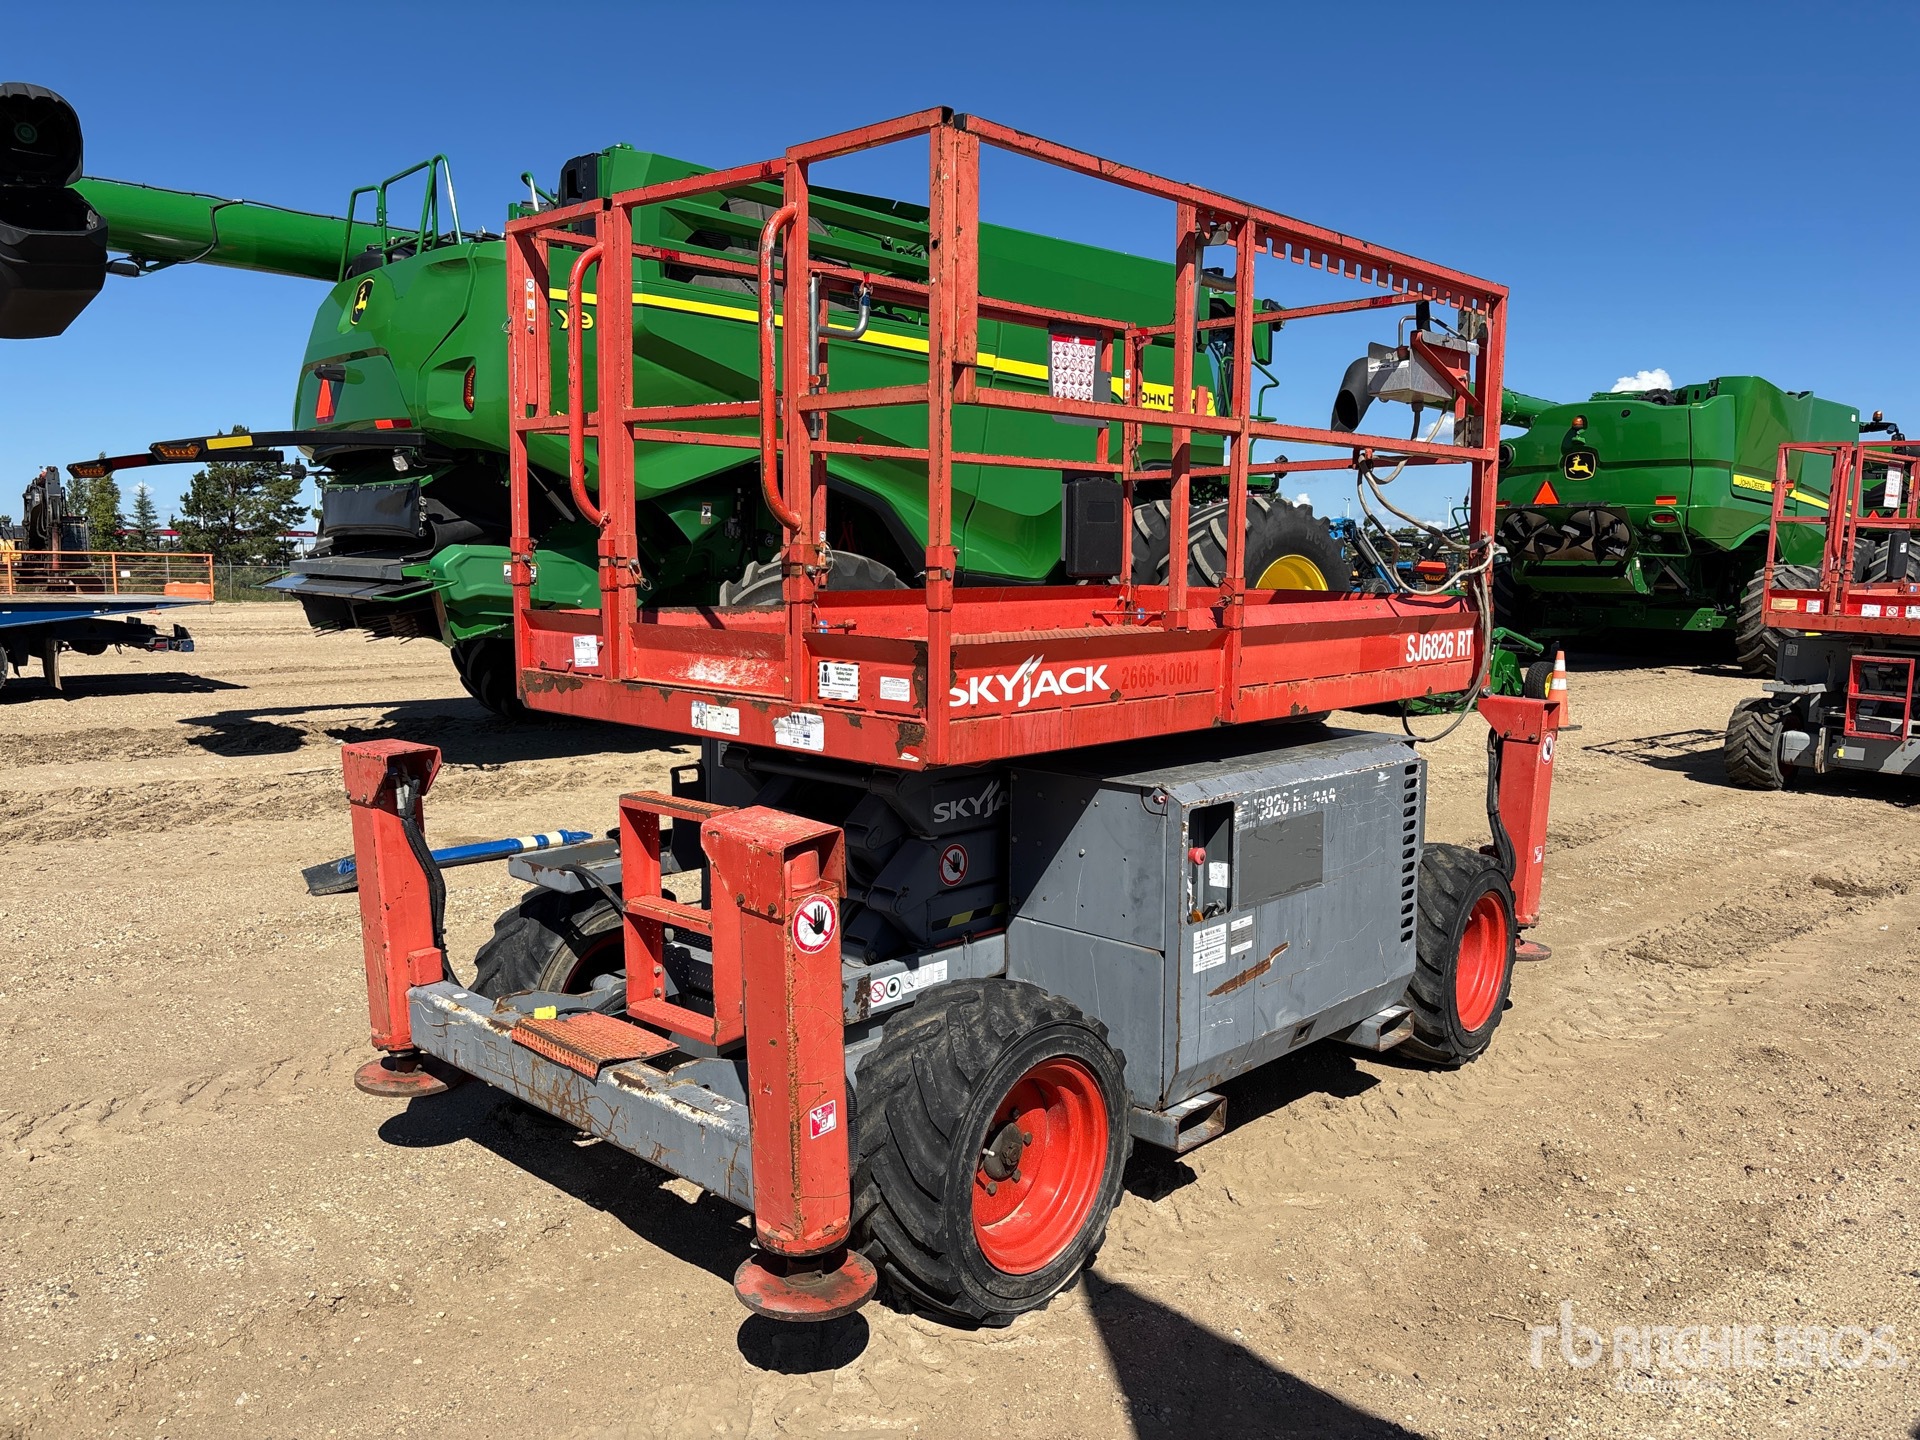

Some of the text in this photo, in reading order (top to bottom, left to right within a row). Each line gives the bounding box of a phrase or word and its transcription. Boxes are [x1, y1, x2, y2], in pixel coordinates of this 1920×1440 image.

[1142, 392, 1165, 405] OHN
[1740, 478, 1766, 490] JOHN DEERE
[1405, 629, 1474, 663] SJ6826 RT
[949, 654, 1111, 707] SKYJACK
[1121, 661, 1200, 689] 2666-10001
[933, 780, 1010, 823] SKYJA
